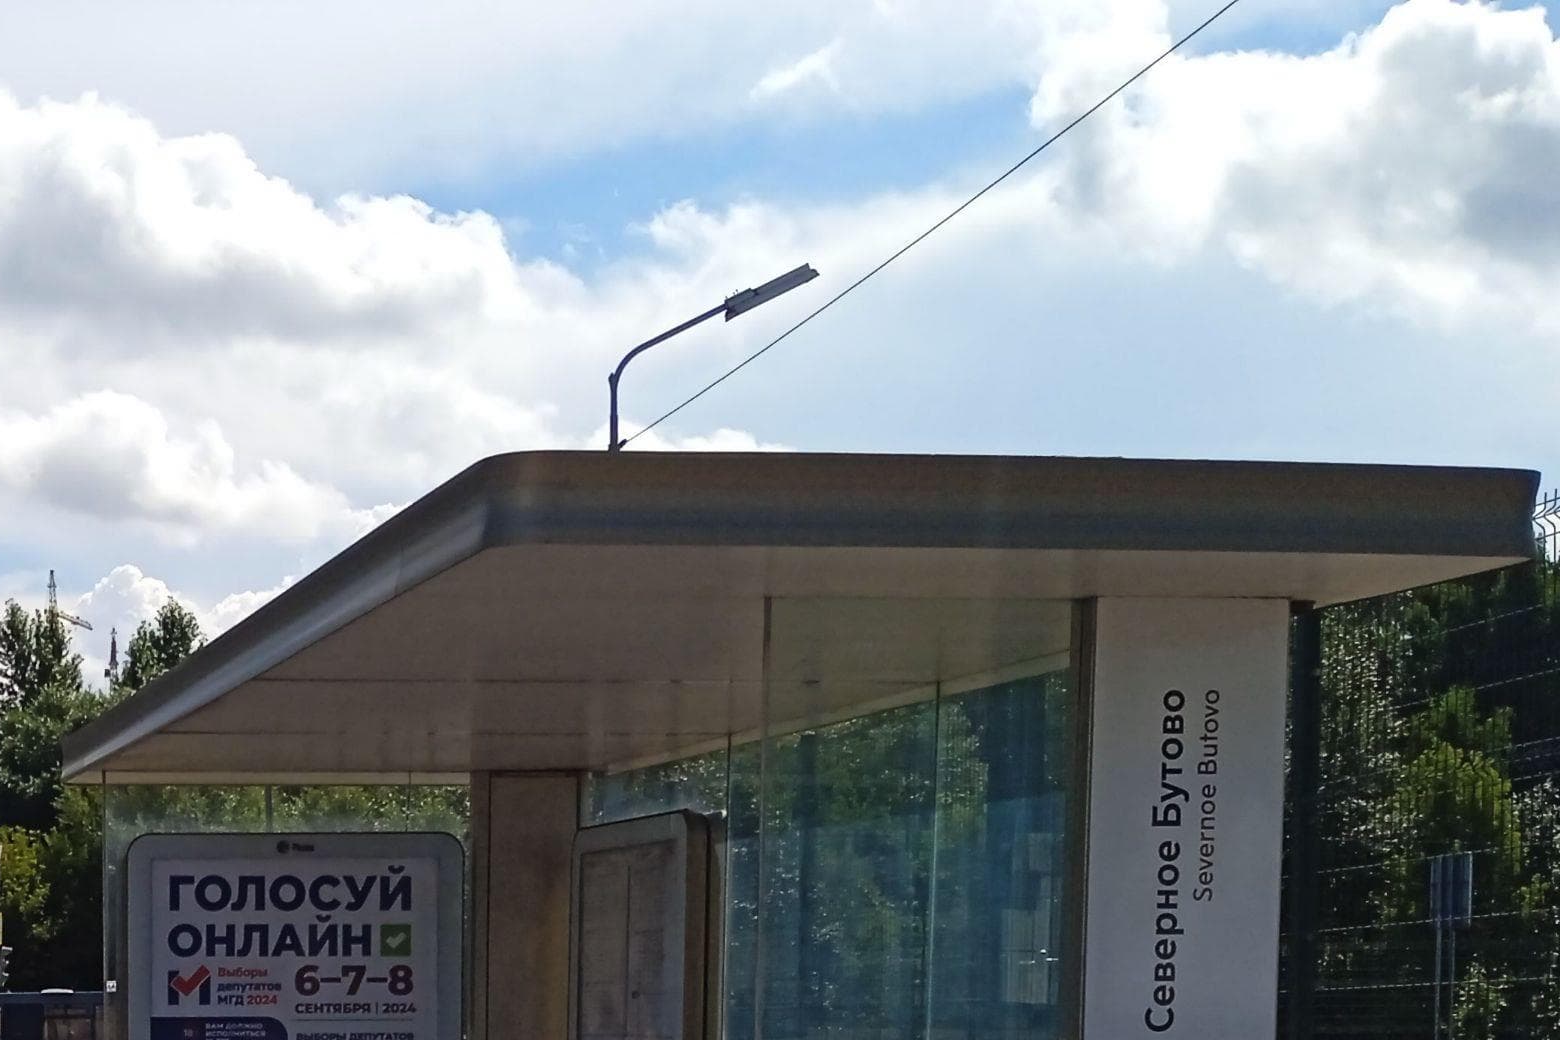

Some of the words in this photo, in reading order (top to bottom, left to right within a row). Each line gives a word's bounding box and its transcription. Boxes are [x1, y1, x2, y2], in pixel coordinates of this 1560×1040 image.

[1197, 689, 1221, 776] Butovo
[1152, 689, 1190, 828] Бутово
[1193, 784, 1218, 902] Severnoe
[169, 865, 412, 912] ГОЛОСУЙ
[167, 914, 372, 958] ОНЛАЙН
[1144, 840, 1185, 1033] Северное
[217, 967, 268, 978] Выборы
[217, 982, 282, 993] депутатов
[217, 995, 244, 1007] МГД
[247, 994, 278, 1005] 2024
[295, 1003, 371, 1014] СЕНТЯБРЯ
[382, 1003, 417, 1014] 2024
[296, 1032, 347, 1040] ВЫБОРЫ
